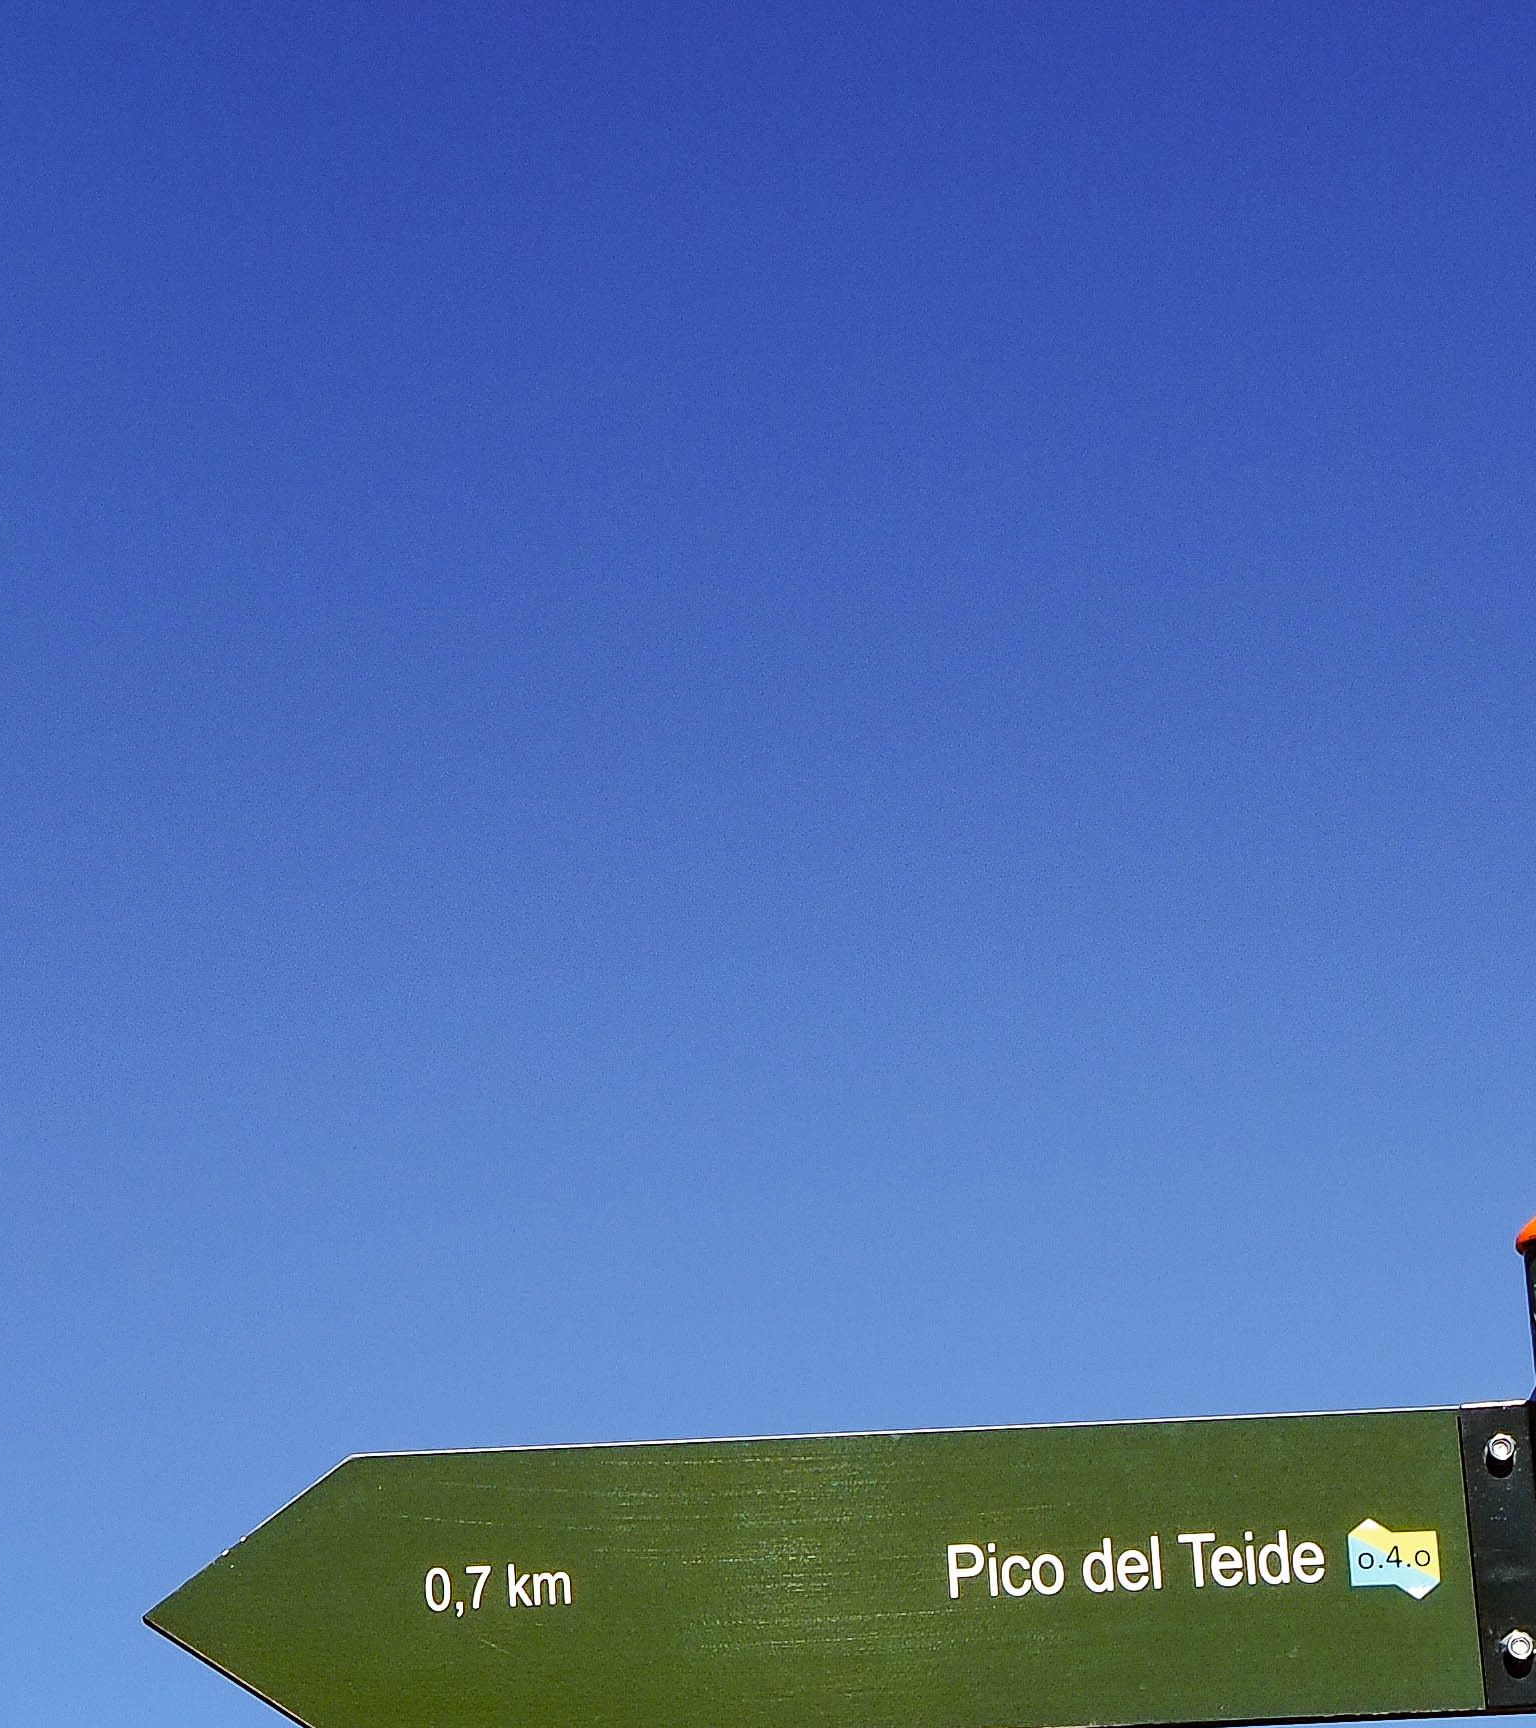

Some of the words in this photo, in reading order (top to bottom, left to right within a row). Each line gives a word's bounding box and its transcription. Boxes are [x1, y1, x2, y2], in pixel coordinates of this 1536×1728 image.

[424, 1565, 492, 1620] 0,7
[507, 1563, 573, 1608] km
[946, 1541, 1066, 1600] Pico
[1082, 1535, 1163, 1594] del
[1177, 1528, 1327, 1589] Teide
